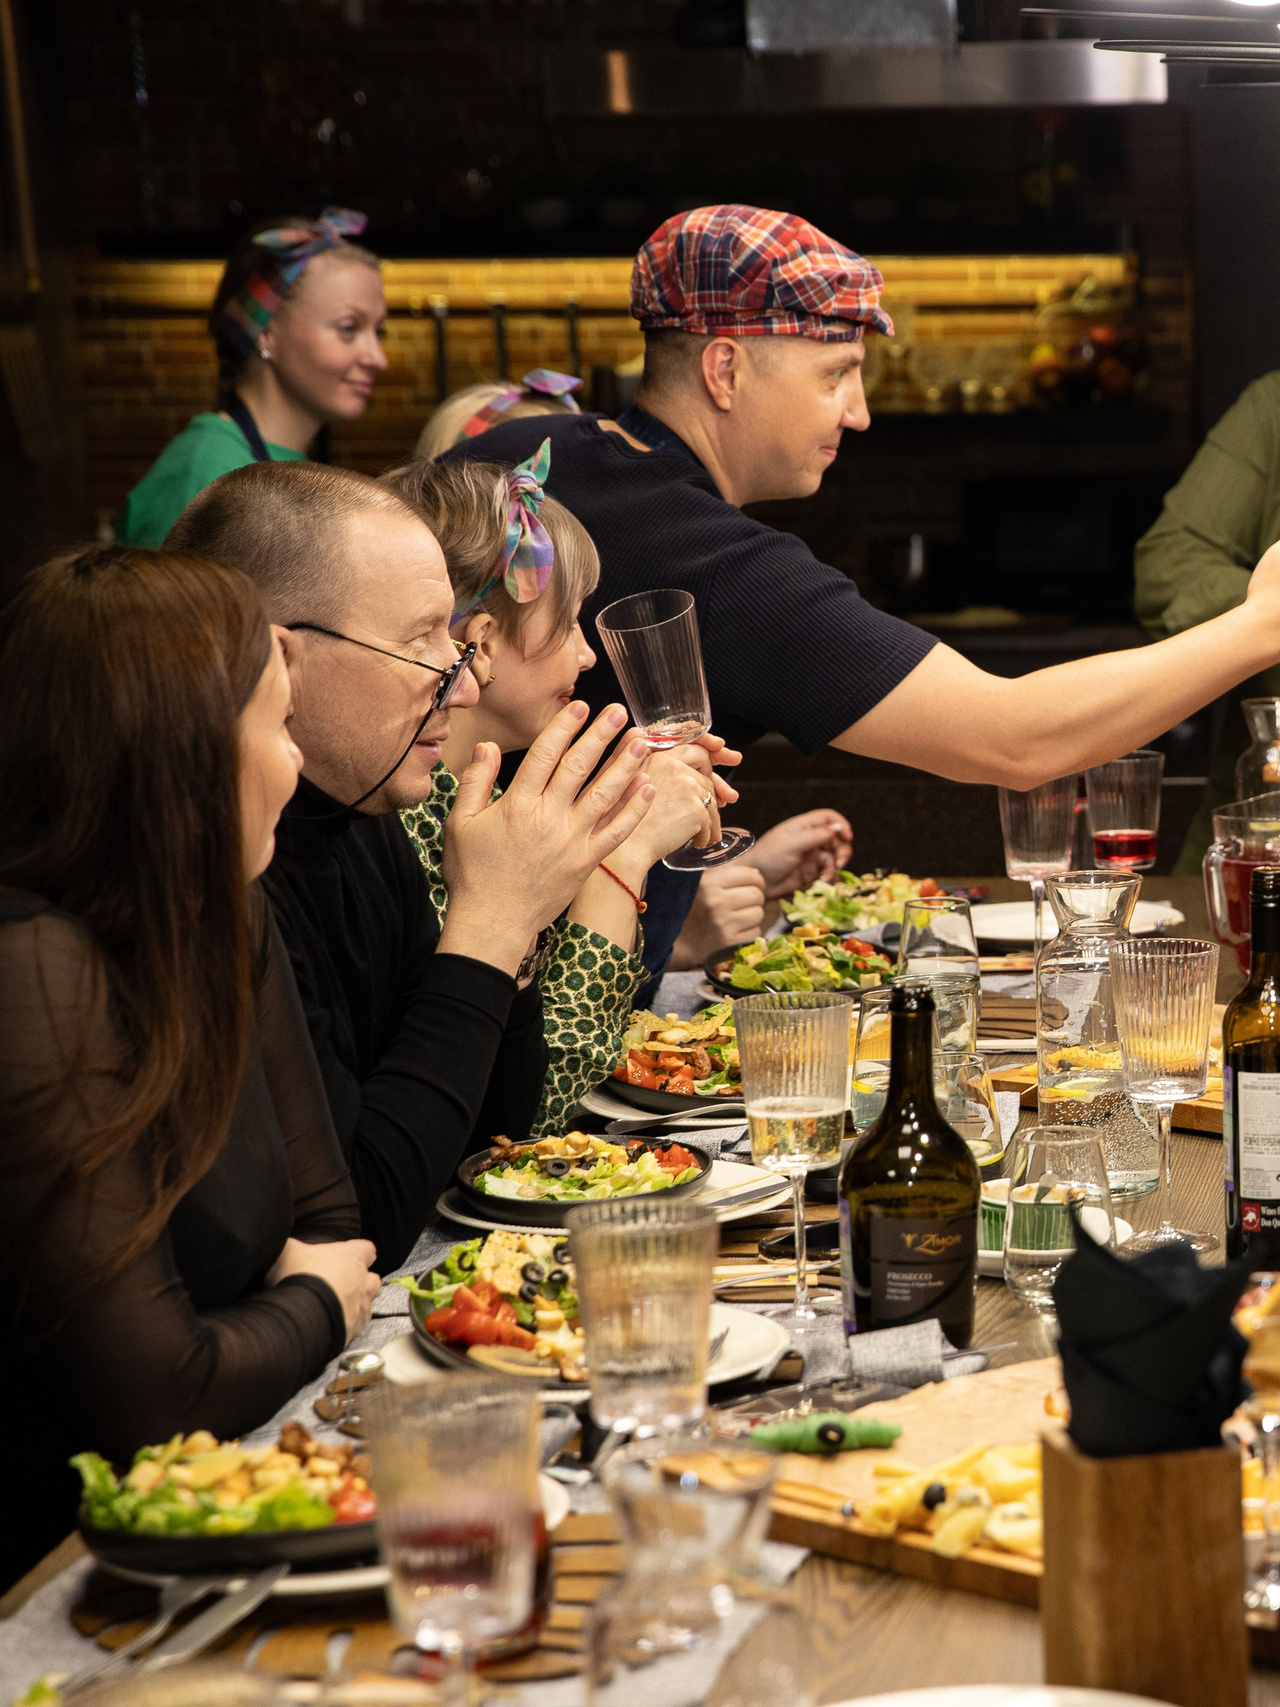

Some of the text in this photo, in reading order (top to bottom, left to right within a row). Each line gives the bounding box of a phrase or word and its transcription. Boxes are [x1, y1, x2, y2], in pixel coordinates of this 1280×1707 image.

[1260, 1206, 1277, 1215] Wines
[1260, 1217, 1272, 1227] Don
[886, 1271, 933, 1280] PROSECCO
